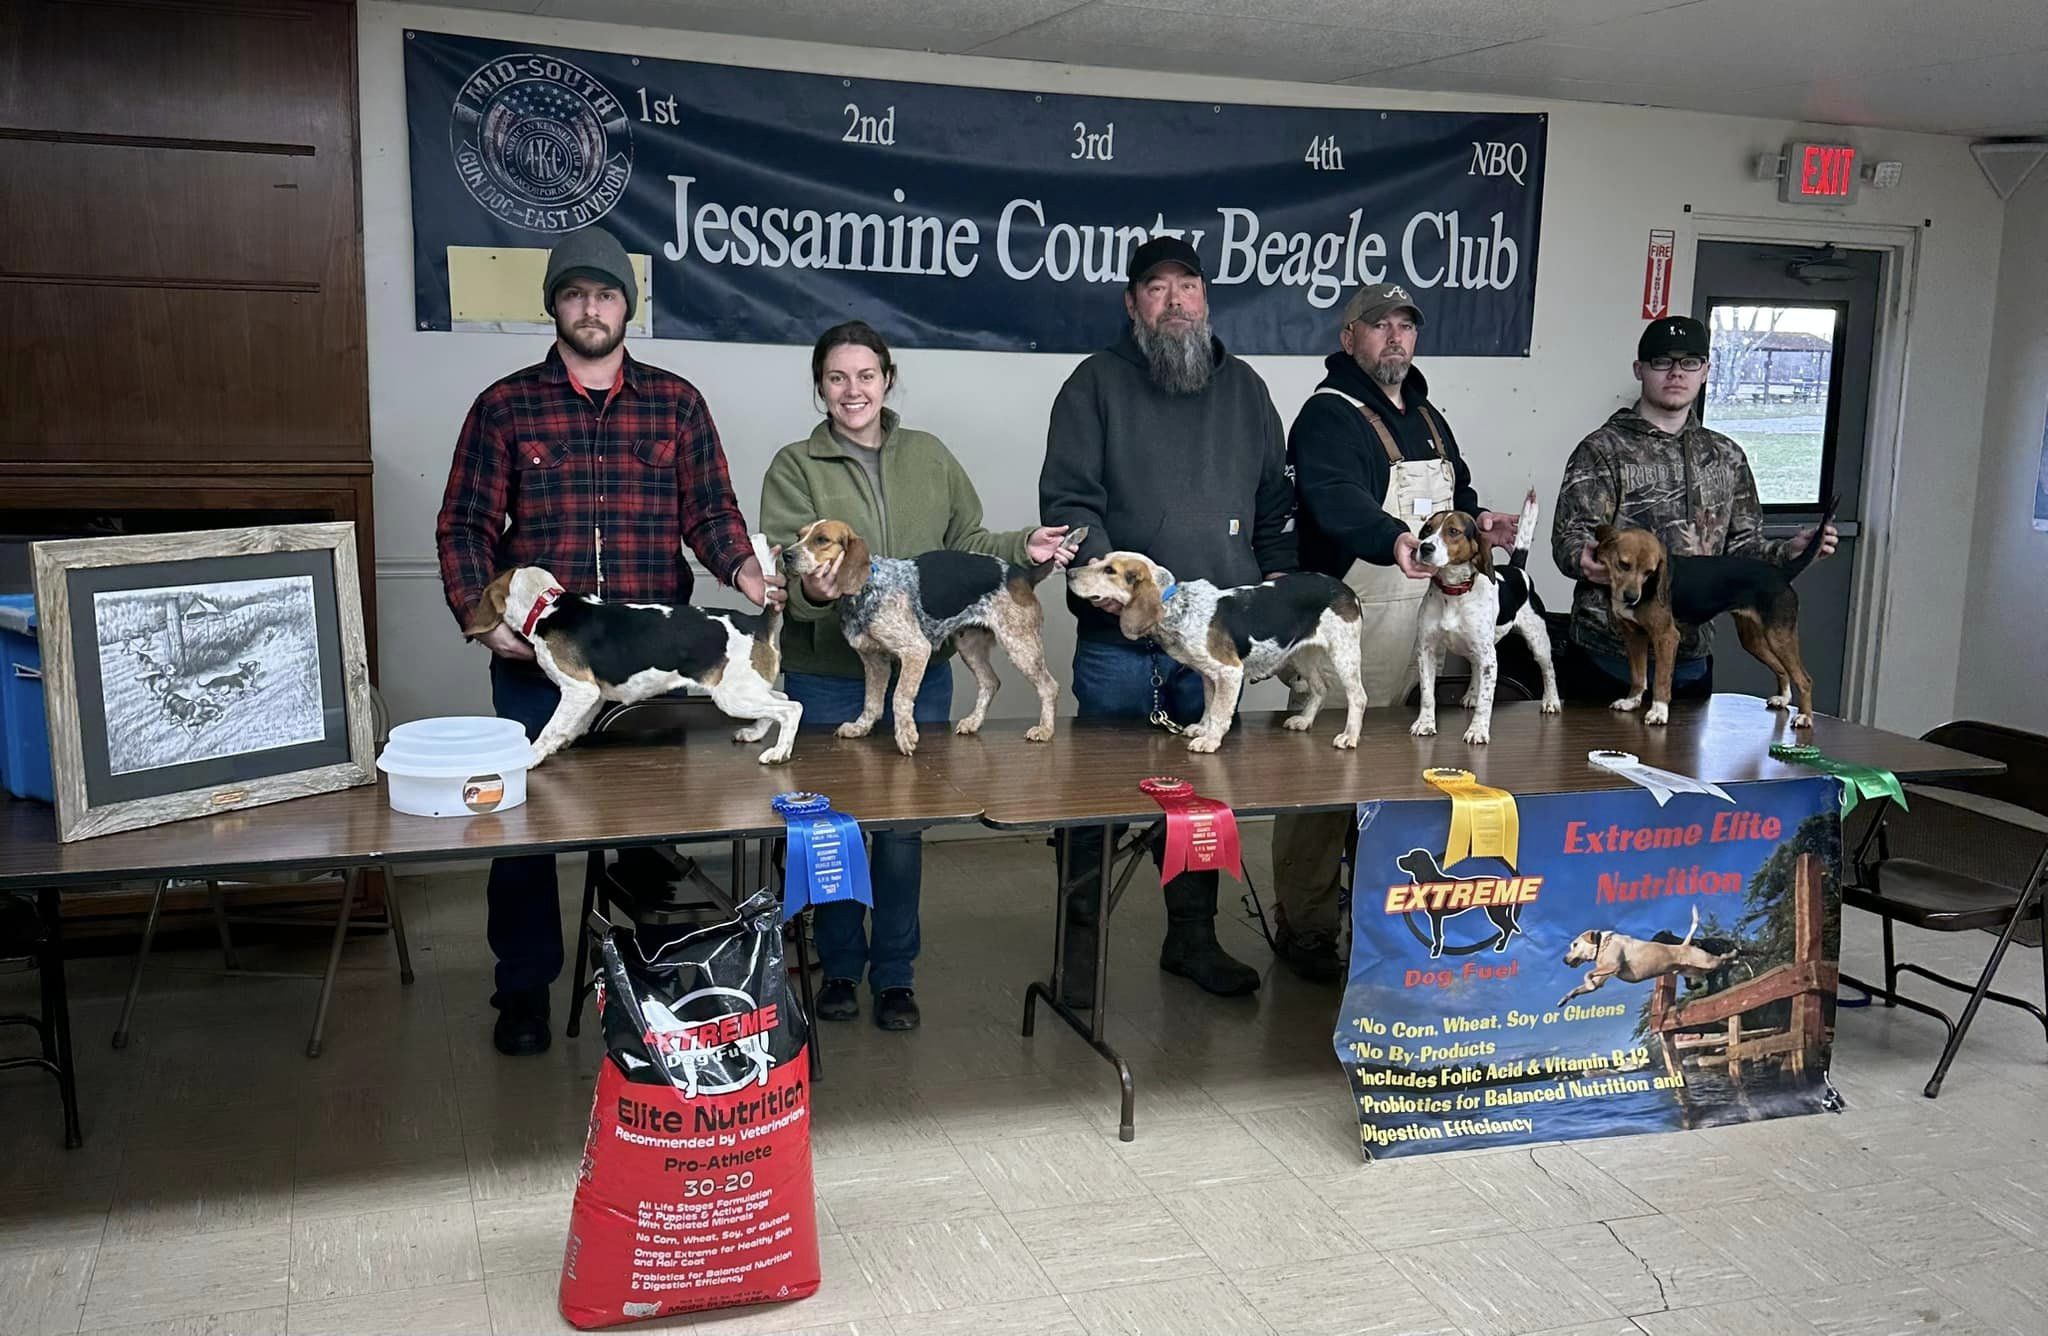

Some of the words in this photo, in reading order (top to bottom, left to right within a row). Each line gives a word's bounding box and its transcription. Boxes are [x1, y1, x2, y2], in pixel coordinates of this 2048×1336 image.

[466, 58, 617, 116] MID-SOUTH
[639, 88, 680, 126] 1st
[842, 103, 896, 146] 2nd
[1071, 122, 1114, 161] 3rd
[1305, 135, 1344, 171] 4th
[1468, 142, 1528, 186] NBQ
[458, 151, 487, 188] GUN
[572, 164, 627, 224] DIVISION
[1801, 145, 1855, 196] EXIT
[663, 174, 981, 278] Jessamine
[1212, 207, 1387, 309] Beagle
[1402, 210, 1519, 290] Club
[1650, 245, 1672, 257] FIRE
[1563, 821, 1703, 854] Extreme
[1710, 810, 1782, 843] Elite
[1385, 875, 1544, 914] EXTREME
[1596, 864, 1743, 905] Nutrition
[1404, 969, 1453, 988] Dog
[1463, 960, 1519, 980] Fuel
[1506, 1010, 1539, 1030] Soy
[1543, 1012, 1560, 1025] or
[1563, 1003, 1626, 1022] Glutens
[667, 1053, 709, 1069] Dog
[716, 1038, 755, 1062] Fuel
[1388, 1041, 1496, 1066] By-Products
[1441, 1068, 1482, 1086] Folic
[1486, 1061, 1523, 1080] Acid
[1526, 1059, 1541, 1076] &
[1543, 1052, 1609, 1074] Vitamin
[1611, 1047, 1650, 1067] B-12
[617, 1095, 683, 1134] Elite
[694, 1079, 804, 1134] Nutrition
[1456, 1094, 1481, 1110] for
[1485, 1080, 1566, 1107] Balanced
[1569, 1076, 1649, 1099] Nutrition
[1653, 1071, 1685, 1091] and
[615, 1125, 715, 1149] Recommended
[719, 1133, 736, 1147] by
[740, 1106, 805, 1141] Veterinarians
[1362, 1121, 1443, 1146] Digestion
[1442, 1117, 1533, 1138] Efficiency
[664, 1144, 773, 1172] Pro-Athlete
[638, 1200, 652, 1210] All
[654, 1202, 674, 1212] Life
[676, 1202, 714, 1213] Stages
[717, 1188, 773, 1209] Formulation
[684, 1171, 754, 1198] 30-20
[635, 1232, 650, 1242] No
[745, 1226, 757, 1235] or
[758, 1212, 790, 1231] Glutens
[637, 1209, 653, 1219] for
[655, 1211, 698, 1223] Puppies
[700, 1211, 709, 1219] &
[711, 1206, 743, 1218] Active
[745, 1199, 769, 1211] Dogs
[638, 1218, 660, 1229] With
[663, 1220, 709, 1230] Chelated
[711, 1212, 754, 1227] Minerals
[634, 1248, 672, 1259] Omega
[674, 1248, 718, 1259] Extreme
[720, 1245, 735, 1254] for
[737, 1235, 773, 1251] Healthy
[774, 1226, 793, 1240] Skin
[632, 1271, 685, 1282] Probiotics
[688, 1271, 704, 1280] for
[705, 1262, 752, 1278] Balanced
[754, 1250, 793, 1270] Nutrition
[633, 1258, 653, 1267] and
[656, 1258, 678, 1267] Hair
[680, 1258, 705, 1267] Coat
[631, 1281, 640, 1289] &
[643, 1281, 692, 1292] Digestion
[695, 1274, 744, 1287] Efficiency
